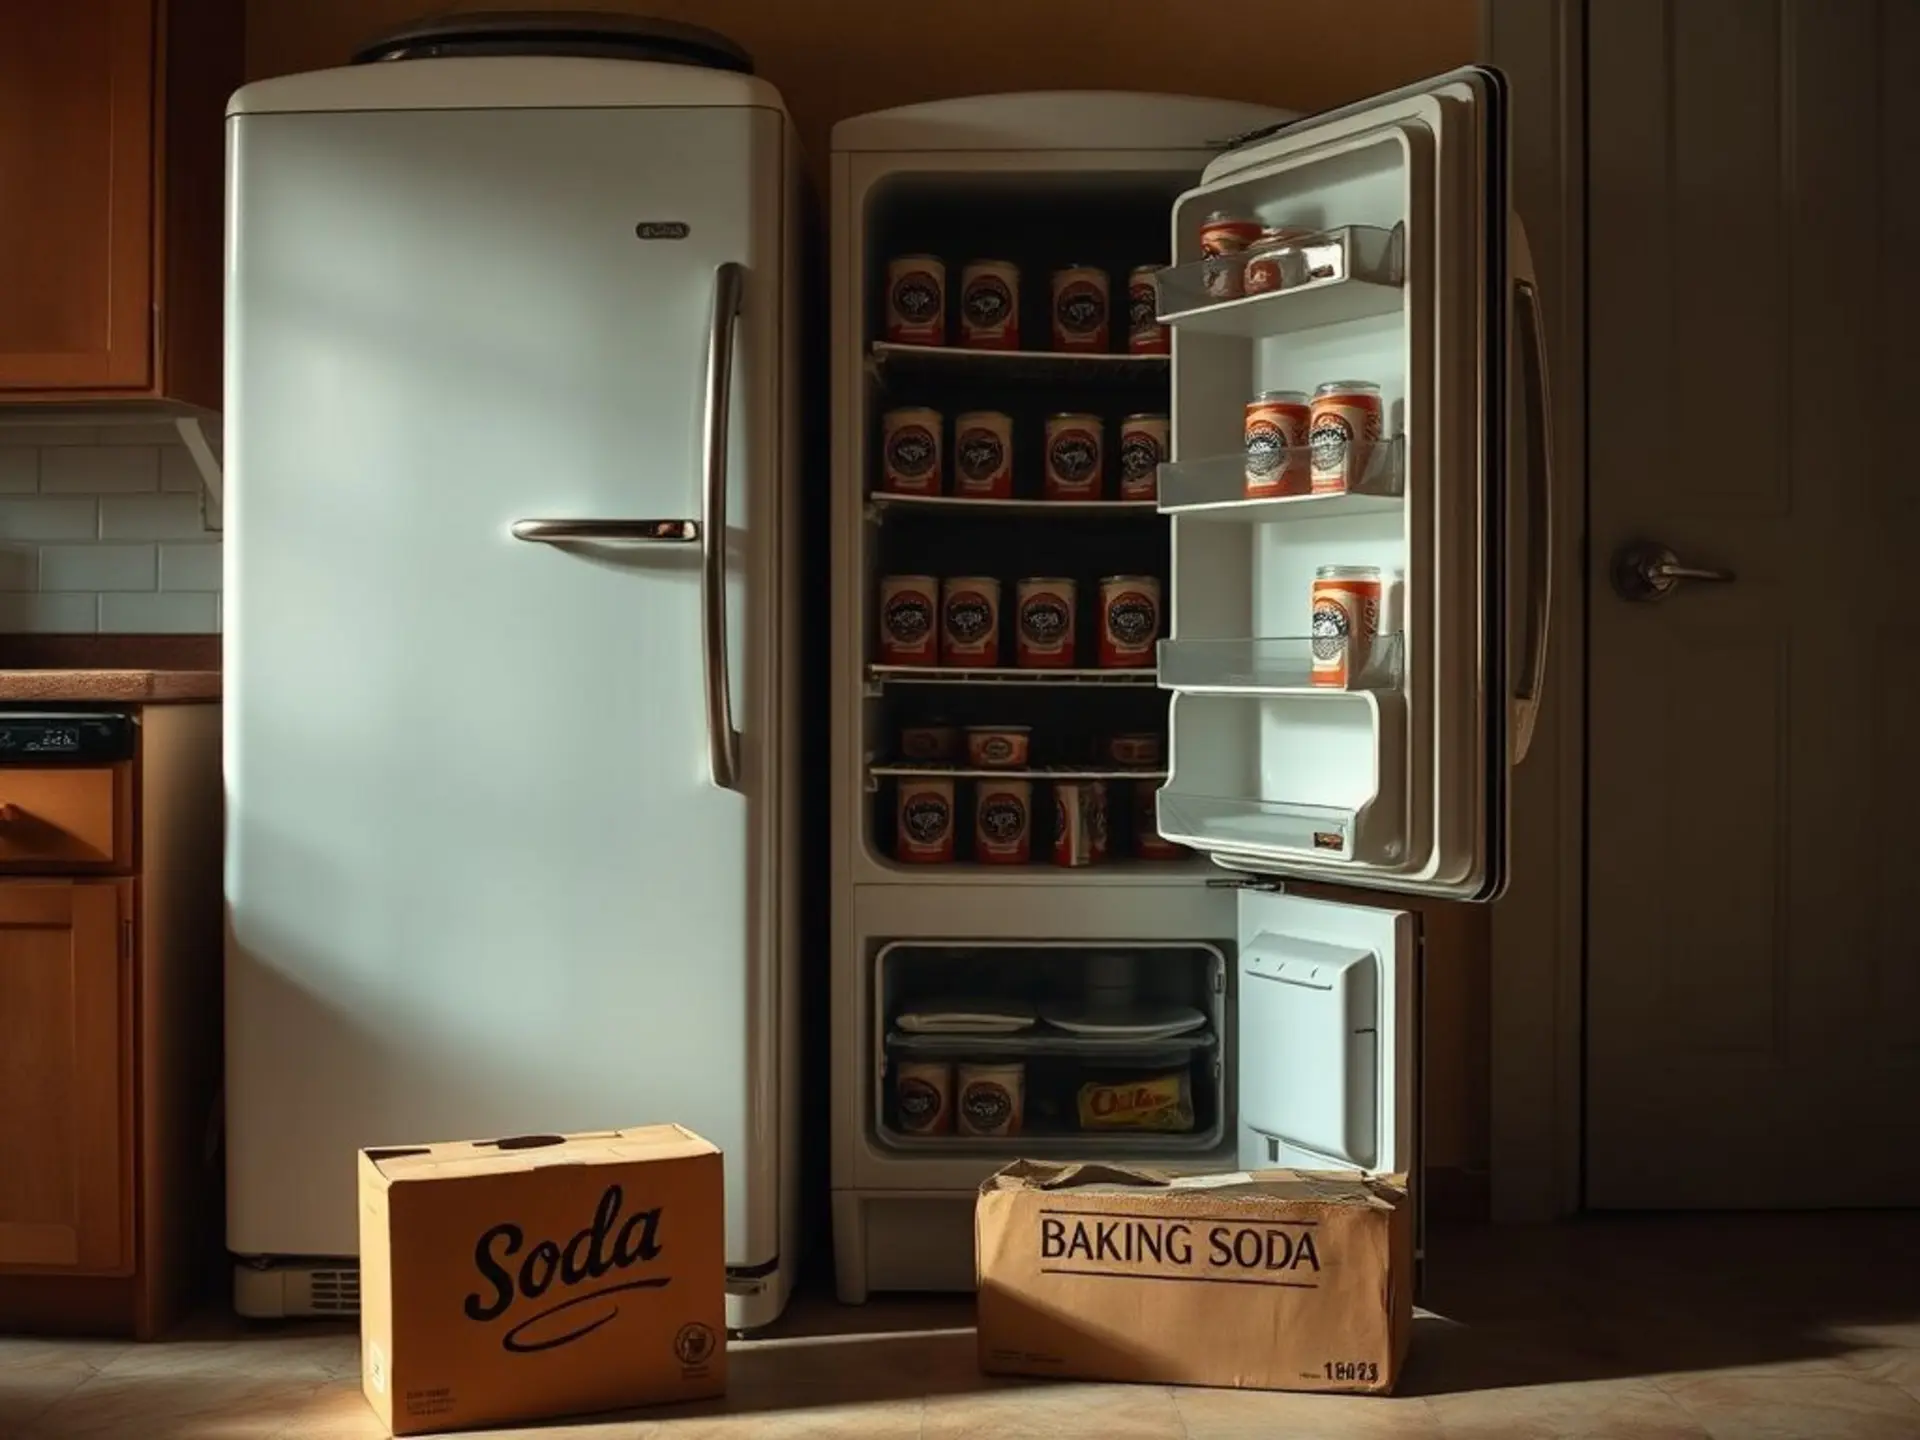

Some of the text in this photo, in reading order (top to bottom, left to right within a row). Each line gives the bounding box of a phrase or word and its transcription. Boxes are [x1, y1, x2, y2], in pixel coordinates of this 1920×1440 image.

[464, 1184, 664, 1322] Soda
[1041, 1218, 1320, 1272] BAKING SODA
